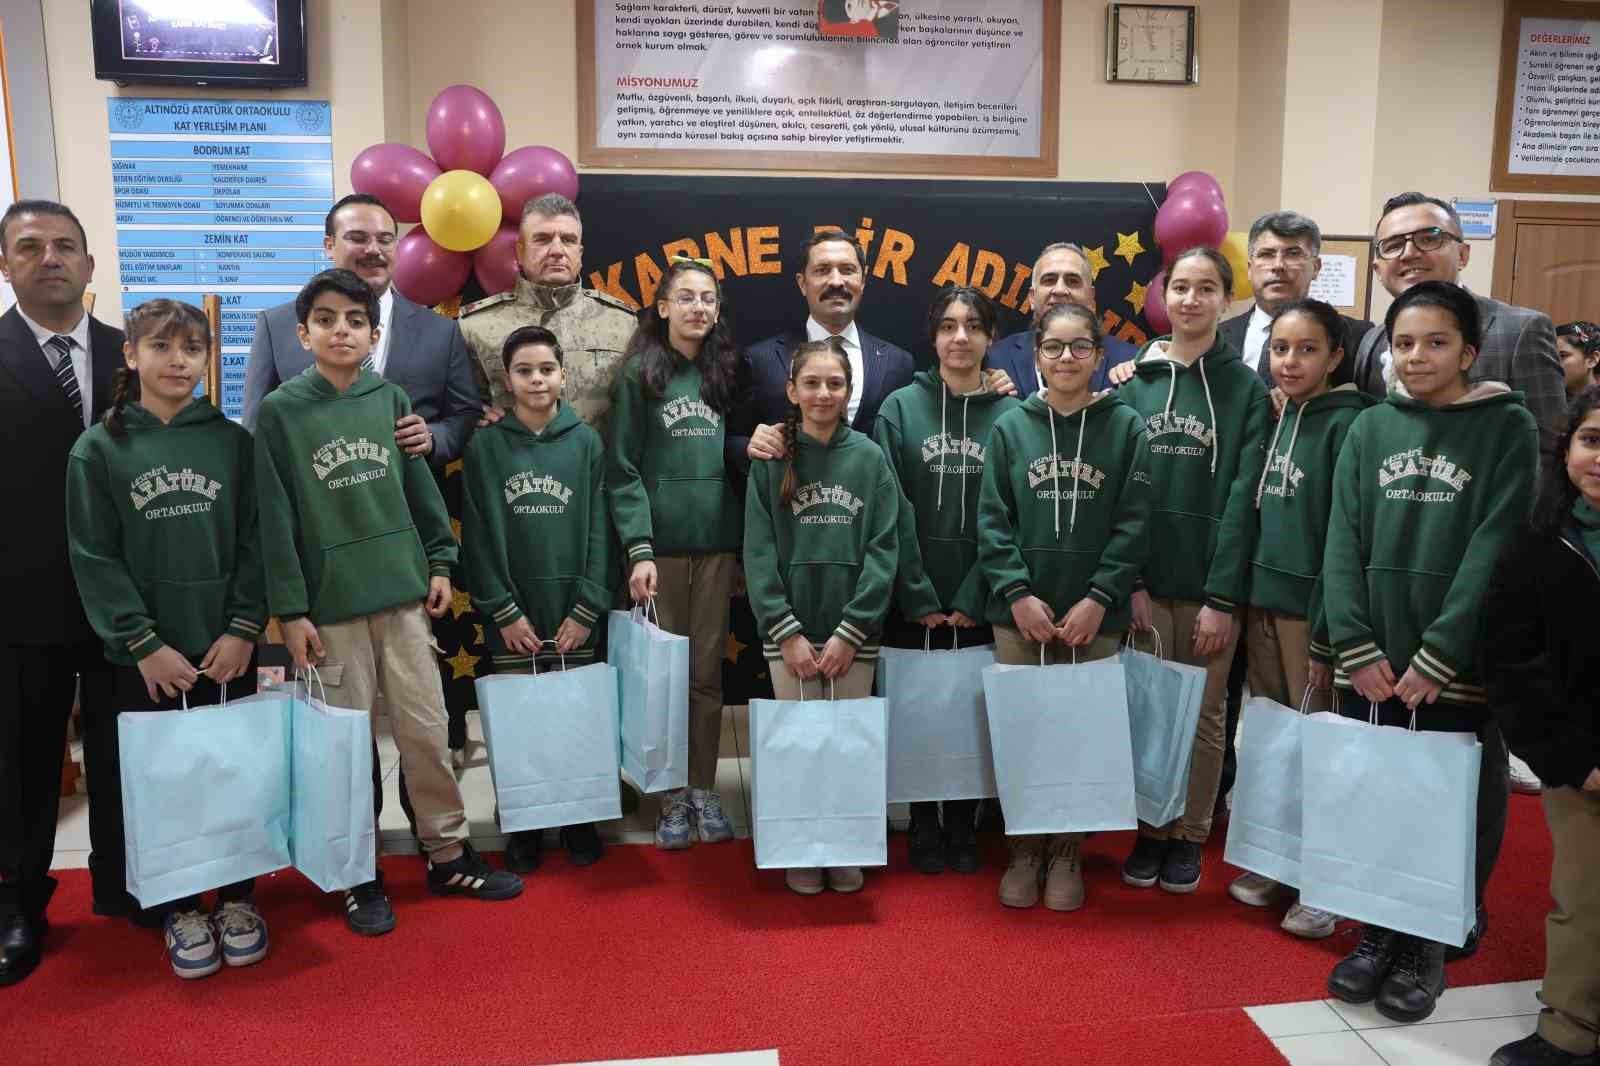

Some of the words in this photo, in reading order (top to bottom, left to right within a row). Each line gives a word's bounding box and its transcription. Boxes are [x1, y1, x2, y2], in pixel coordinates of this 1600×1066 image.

[616, 3, 650, 14] Sağlam
[654, 4, 700, 14] karakterli,
[703, 5, 734, 15] dürüst,
[737, 6, 770, 15] kuvvetli
[774, 7, 786, 15] bir
[789, 8, 814, 16] vatan
[616, 16, 641, 24] kendi
[644, 16, 681, 26] ayakları
[684, 17, 724, 26] üzerinde
[727, 18, 772, 28] durabilen,
[776, 20, 800, 29] kendi
[915, 12, 950, 21] ülkesine
[953, 14, 984, 24] yararlı,
[919, 26, 973, 35] başkalarının
[976, 28, 1011, 37] düşünce
[616, 28, 660, 37] haklarına
[663, 31, 687, 40] saygı
[690, 31, 732, 40] gösteren,
[735, 32, 760, 41] görev
[925, 39, 969, 49] öğrenciler
[972, 40, 1011, 49] yetiştiren
[616, 41, 642, 49] örnek
[645, 42, 674, 50] kurum
[677, 43, 708, 51] olmak.
[616, 75, 699, 88] MİSYONUMUZ
[616, 93, 645, 102] Mutlu,
[648, 93, 694, 104] özgüvenli,
[697, 94, 732, 104] başarılı,
[762, 96, 795, 105] duyarlı,
[798, 96, 816, 106] açık
[820, 96, 844, 106] fikirli,
[944, 100, 975, 110] iletişim
[978, 101, 1017, 111] becerileri
[144, 104, 189, 114] ALTINÖZÜ
[192, 104, 233, 115] ATATÜRK
[235, 106, 290, 116] ORTAOKULU
[616, 105, 656, 115] gelişmiş,
[659, 107, 710, 116] öğrenmeye
[726, 108, 772, 116] yeniliklere
[776, 107, 795, 117] açık,
[868, 112, 932, 120] değerlendirme
[174, 122, 191, 131] KAT
[193, 120, 238, 133] YERLEŞİM
[240, 122, 266, 131] PLANI
[616, 118, 648, 127] yatkın,
[650, 119, 684, 128] yaratıcı
[700, 120, 735, 128] eleştirel
[738, 120, 778, 130] düşünen,
[782, 121, 807, 130] akılcı,
[810, 122, 850, 130] cesaretli,
[853, 123, 868, 132] çok
[871, 124, 897, 132] yönlü,
[900, 124, 926, 132] ulusal
[928, 125, 969, 134] kültürünü
[617, 130, 637, 139] aynı
[685, 131, 717, 140] küresel
[720, 132, 744, 142] bakış
[747, 133, 778, 142] açısına
[782, 133, 806, 144] sahip
[809, 134, 841, 144] bireyler
[193, 145, 232, 155] BODRUM
[235, 146, 250, 155] KAT
[204, 232, 231, 244] ZEMİN
[233, 234, 248, 245] KAT
[223, 356, 245, 365] 2.KAT
[313, 438, 390, 480] ATATÜRK
[328, 468, 386, 489] ORTAOKULU
[1379, 455, 1472, 491] ATATÜRK
[130, 468, 222, 510] ATATÜRK
[504, 475, 574, 505] ATATÜRK
[1386, 489, 1456, 502] ORTAOKULU
[792, 484, 864, 516] ATATÜRK
[145, 502, 213, 520] ORTAOKULU
[514, 505, 564, 514] ORTAOKULU
[800, 516, 853, 525] ORTAOKULU
